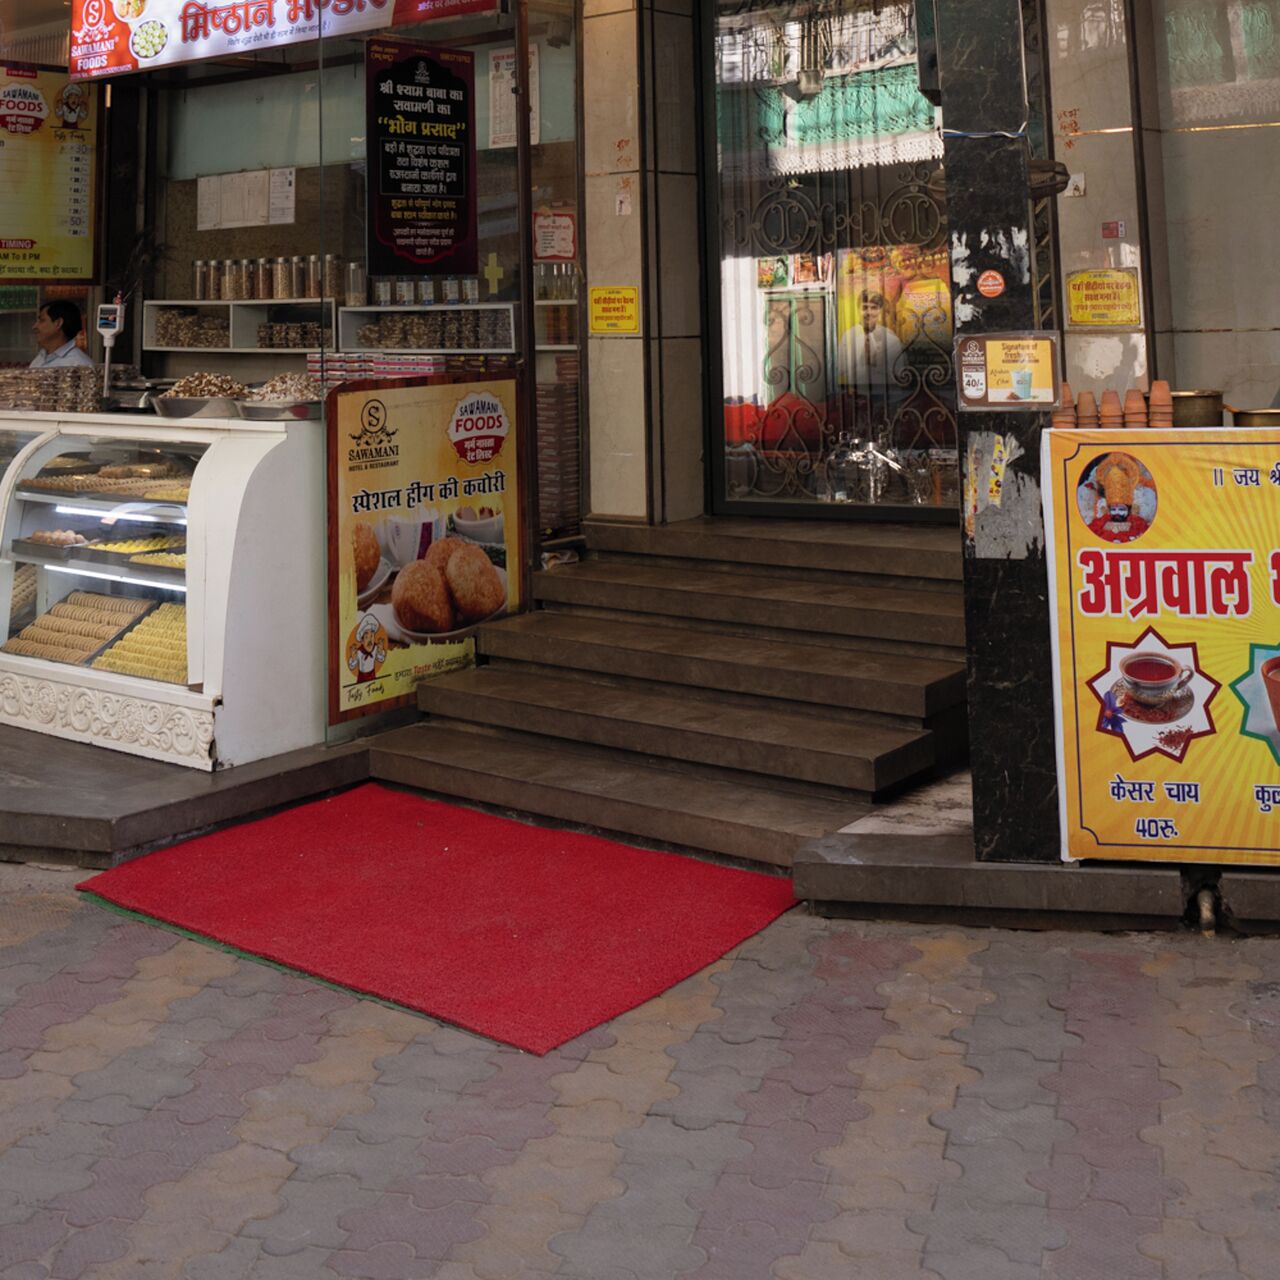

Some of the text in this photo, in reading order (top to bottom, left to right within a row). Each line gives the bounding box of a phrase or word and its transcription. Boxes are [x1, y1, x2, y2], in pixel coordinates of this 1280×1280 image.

[77, 55, 108, 71] FOODS
[379, 79, 464, 101] श्री श्याम बाबा का
[393, 99, 452, 115] सवामणी का
[0, 239, 32, 250] TIMING
[11, 252, 20, 260] To
[28, 252, 40, 261] PM
[965, 379, 983, 388] 40/-
[459, 399, 499, 417] SAWAMANI
[455, 414, 503, 433] FOODS
[348, 445, 399, 462] SAWAMANI
[1232, 465, 1261, 488] जय
[352, 469, 506, 513] स्पेशल हींग की कचोरी
[1077, 547, 1253, 620] अग्रवाल
[1109, 774, 1200, 802] केसर चाय
[1134, 816, 1179, 840] 40रु.
